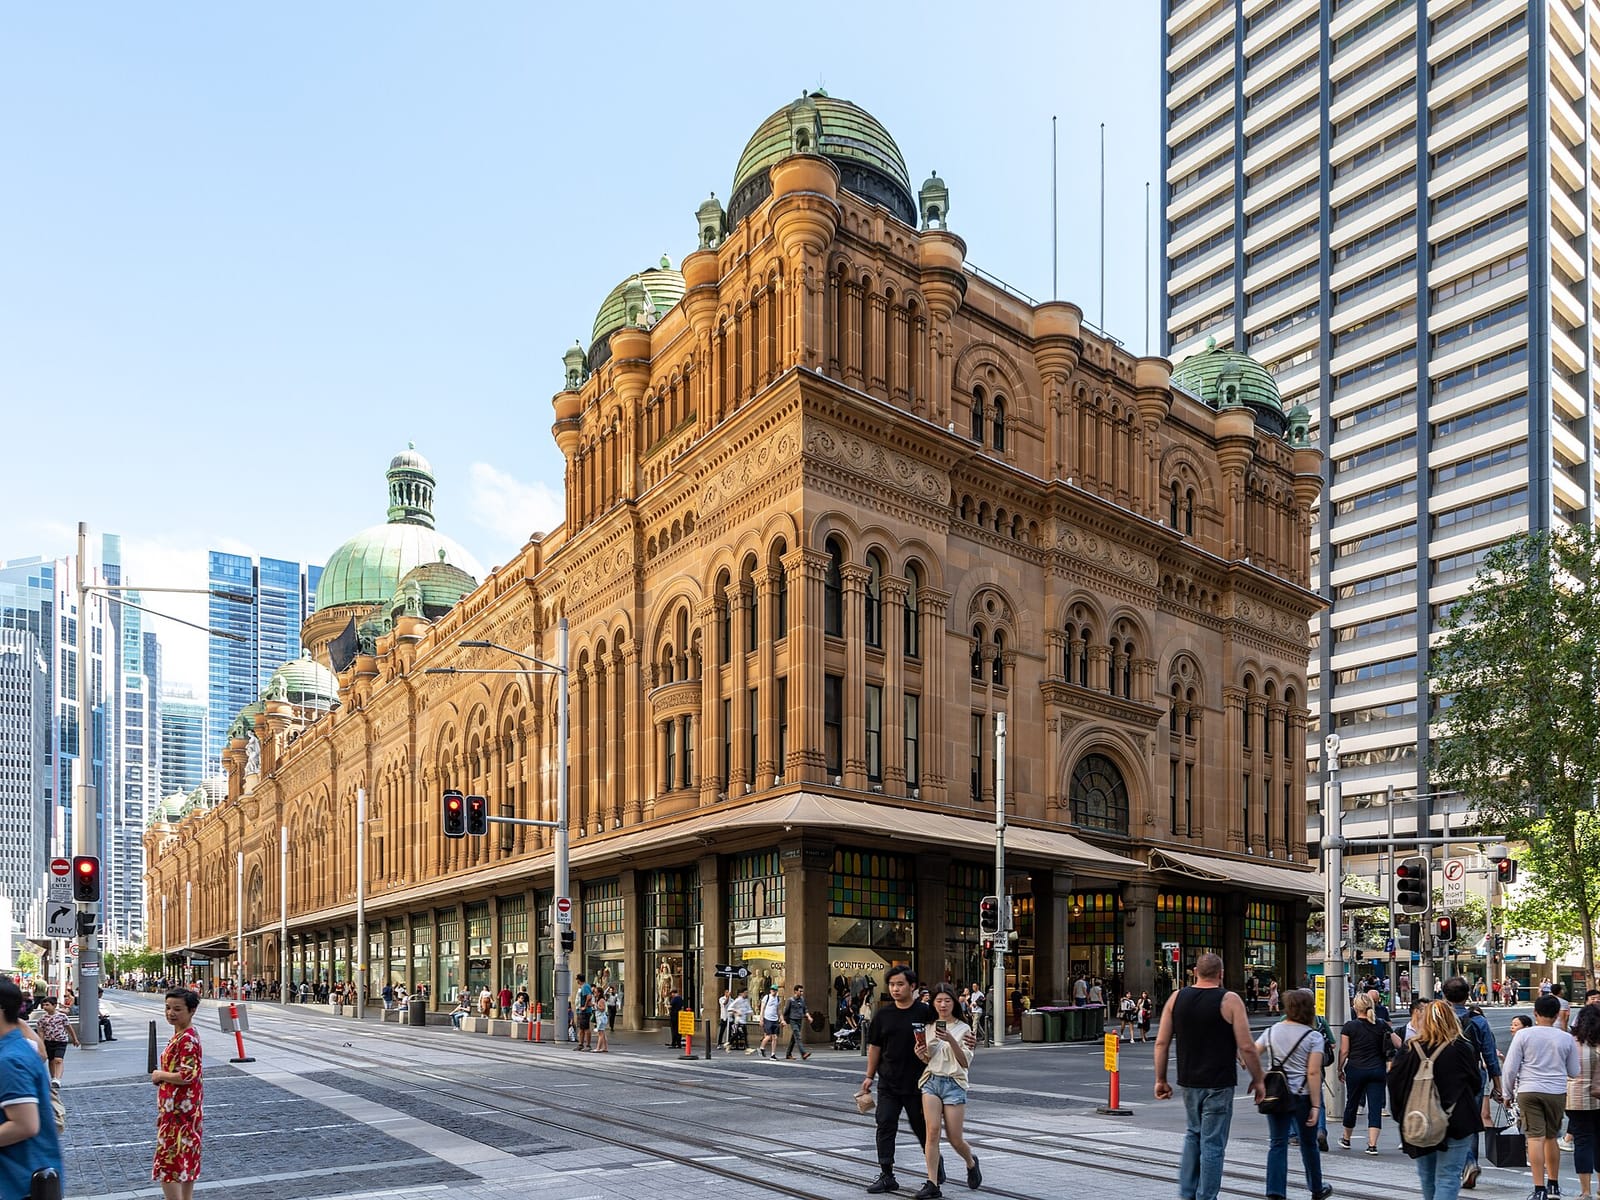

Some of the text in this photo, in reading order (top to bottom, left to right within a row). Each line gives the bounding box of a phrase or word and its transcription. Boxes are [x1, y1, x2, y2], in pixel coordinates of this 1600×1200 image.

[48, 926, 73, 934] ONLY
[833, 961, 885, 970] COUNTRY ROAD
